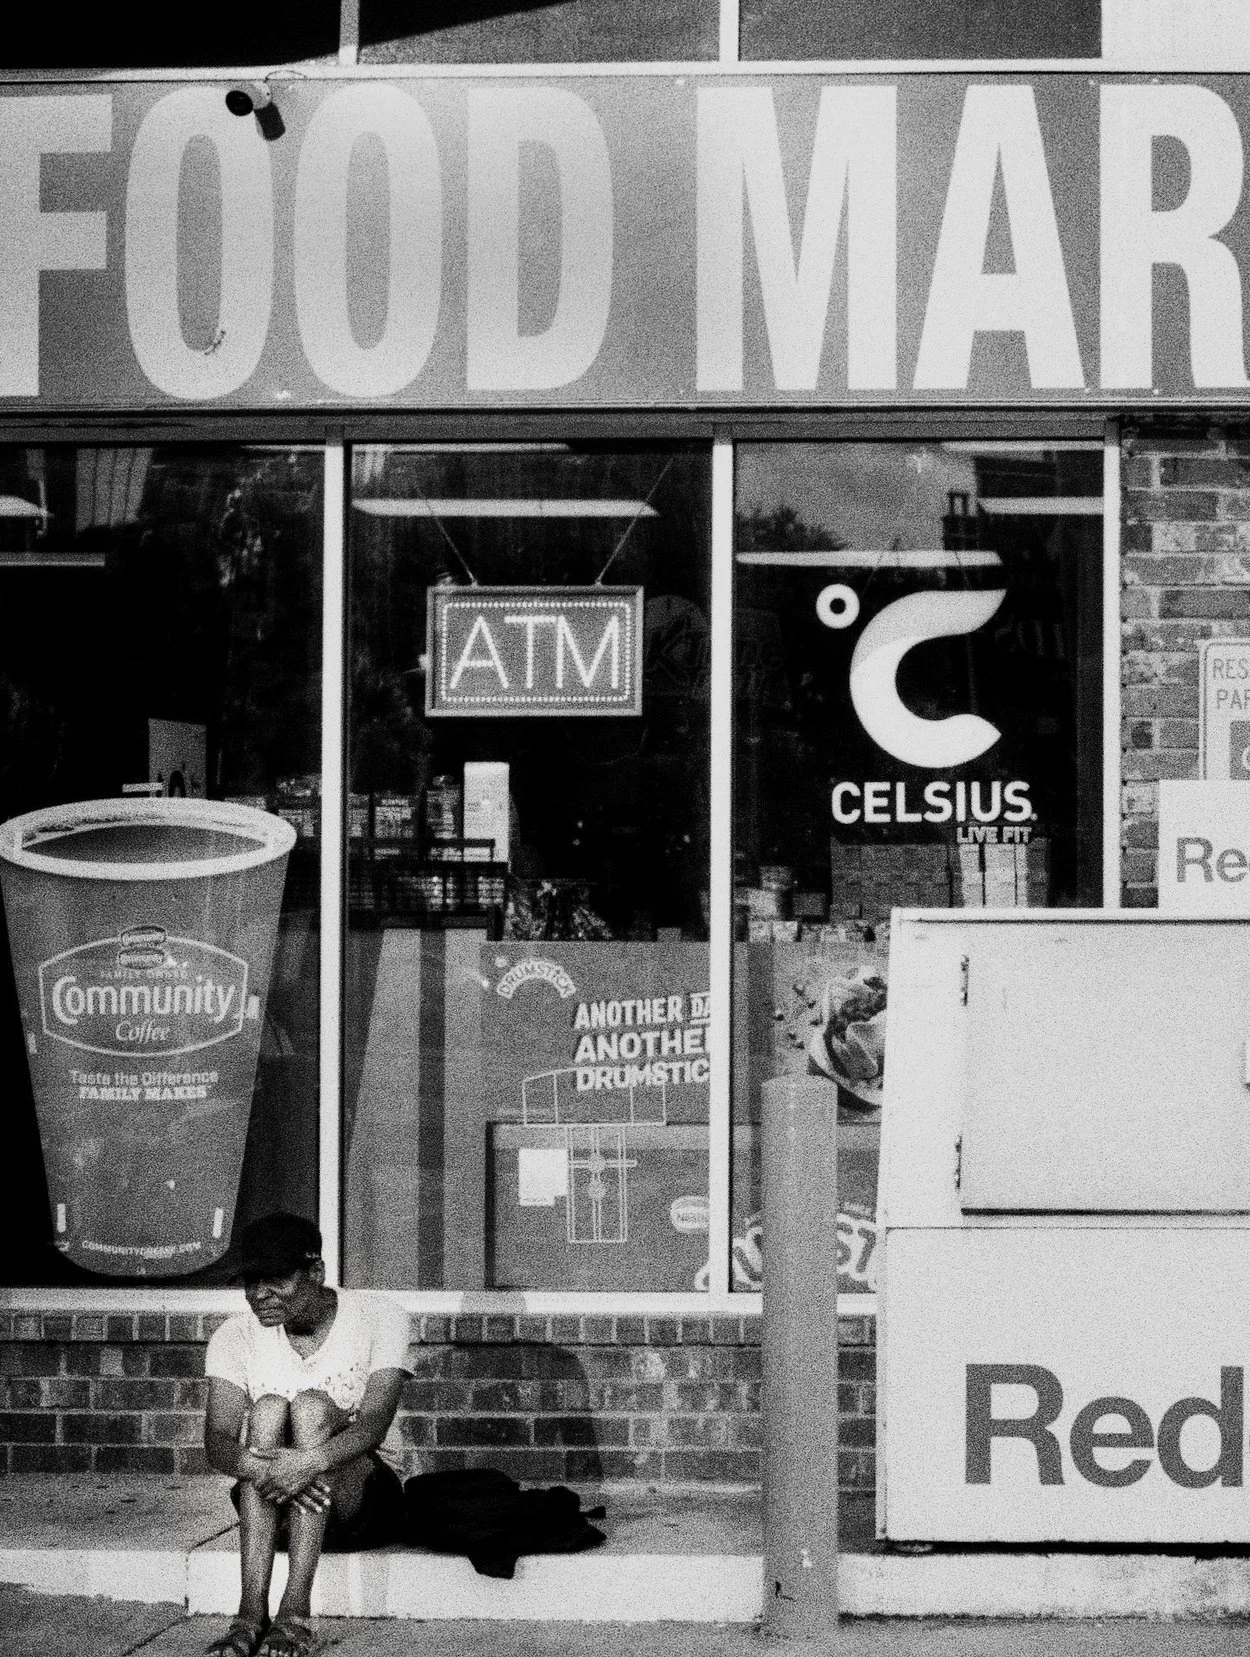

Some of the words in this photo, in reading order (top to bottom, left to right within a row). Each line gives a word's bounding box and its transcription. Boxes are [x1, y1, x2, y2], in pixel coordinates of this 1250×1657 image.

[0, 84, 613, 399] FOOD
[450, 614, 620, 690] ATM
[956, 826, 998, 844] LIVE
[1002, 826, 1032, 844] FIT
[496, 956, 577, 999] DRUMSTICK
[52, 974, 235, 1025] Community
[575, 995, 683, 1030] ANOTHER
[115, 1019, 170, 1043] Coffee
[575, 1028, 710, 1063] ANOTHE
[69, 1069, 111, 1085] Taste
[114, 1072, 138, 1085] the
[141, 1071, 218, 1085] Difference
[79, 1087, 141, 1100] FAMILY
[144, 1086, 207, 1100] MAKES
[576, 1059, 710, 1092] DRUMSTIC
